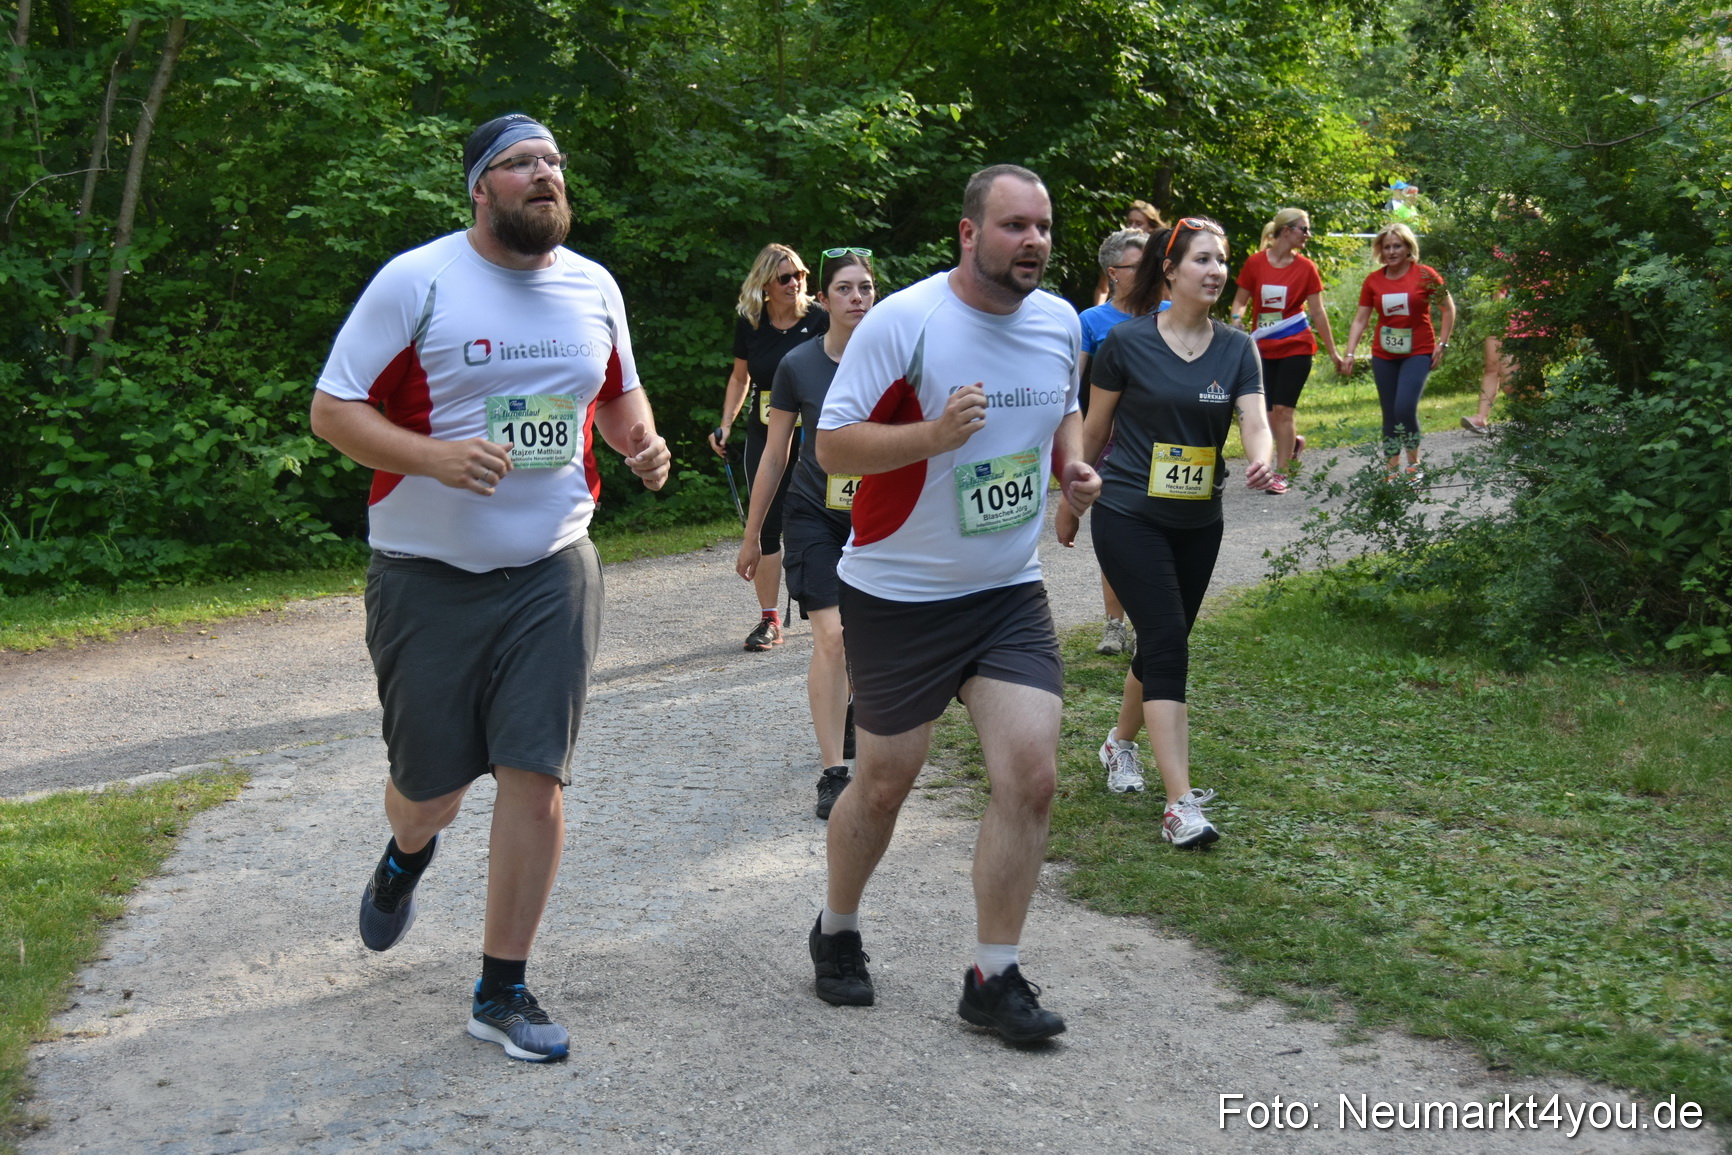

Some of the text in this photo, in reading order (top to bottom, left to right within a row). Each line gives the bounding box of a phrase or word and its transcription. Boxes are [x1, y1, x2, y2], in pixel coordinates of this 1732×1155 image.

[499, 339, 601, 361] intellitools
[1385, 336, 1404, 346] 534
[985, 385, 1065, 408] ntellitools
[502, 421, 568, 447] 1098
[511, 449, 536, 457] Rajzer
[1166, 465, 1203, 485] 414
[970, 476, 1034, 514] 1094
[983, 505, 1028, 521] Blaschek Jörg
